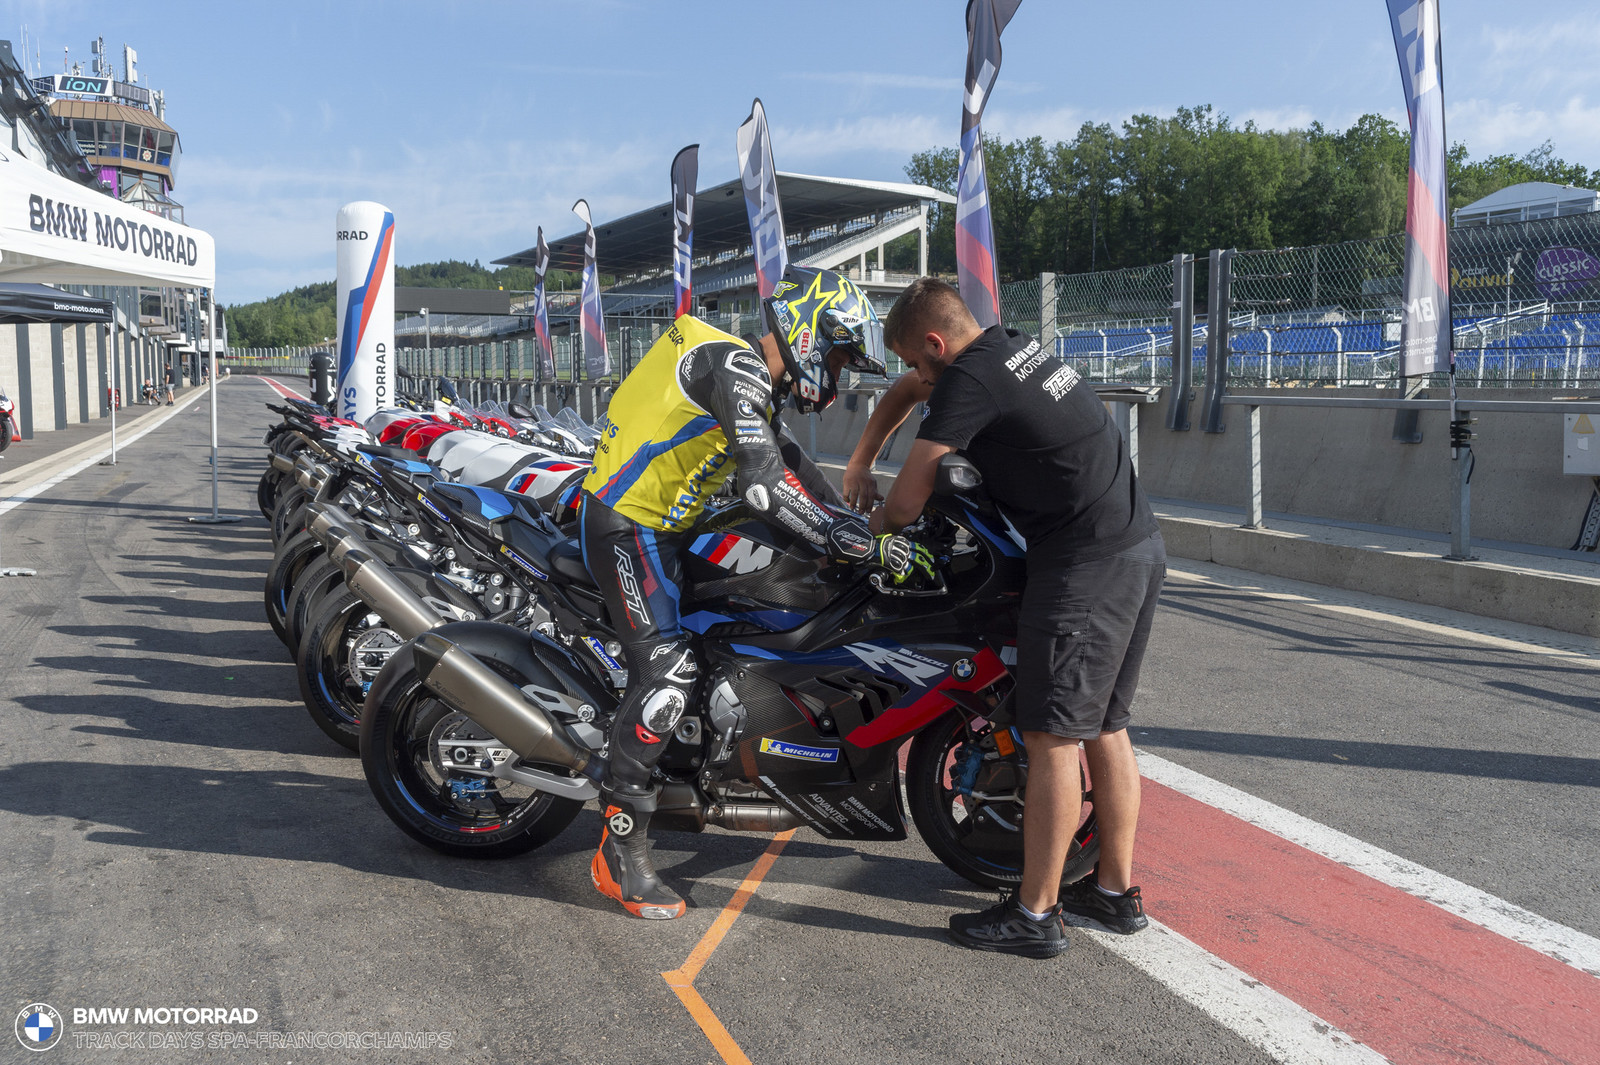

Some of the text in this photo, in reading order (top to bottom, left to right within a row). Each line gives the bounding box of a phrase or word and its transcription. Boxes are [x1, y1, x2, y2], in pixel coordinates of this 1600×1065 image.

[29, 193, 197, 267] BMW MOTORRAD
[337, 230, 369, 241] RRAD
[1539, 258, 1591, 278] CLASSIC
[54, 302, 105, 314] bmc-moto.com
[800, 332, 810, 355] BELL
[1005, 350, 1029, 372] BMW
[733, 385, 764, 405] Kevlar
[735, 380, 766, 398] BUILT WITH
[736, 436, 767, 444] Bihr
[773, 487, 825, 526] MOTORSPORT
[778, 480, 835, 523] BMW MOTORRA
[614, 545, 651, 625] RST
[784, 747, 833, 759] MICHELIN
[809, 793, 848, 824] ADVANTEC
[839, 801, 878, 830] MOTORSPORT
[847, 796, 894, 833] BMW MOTORRAD
